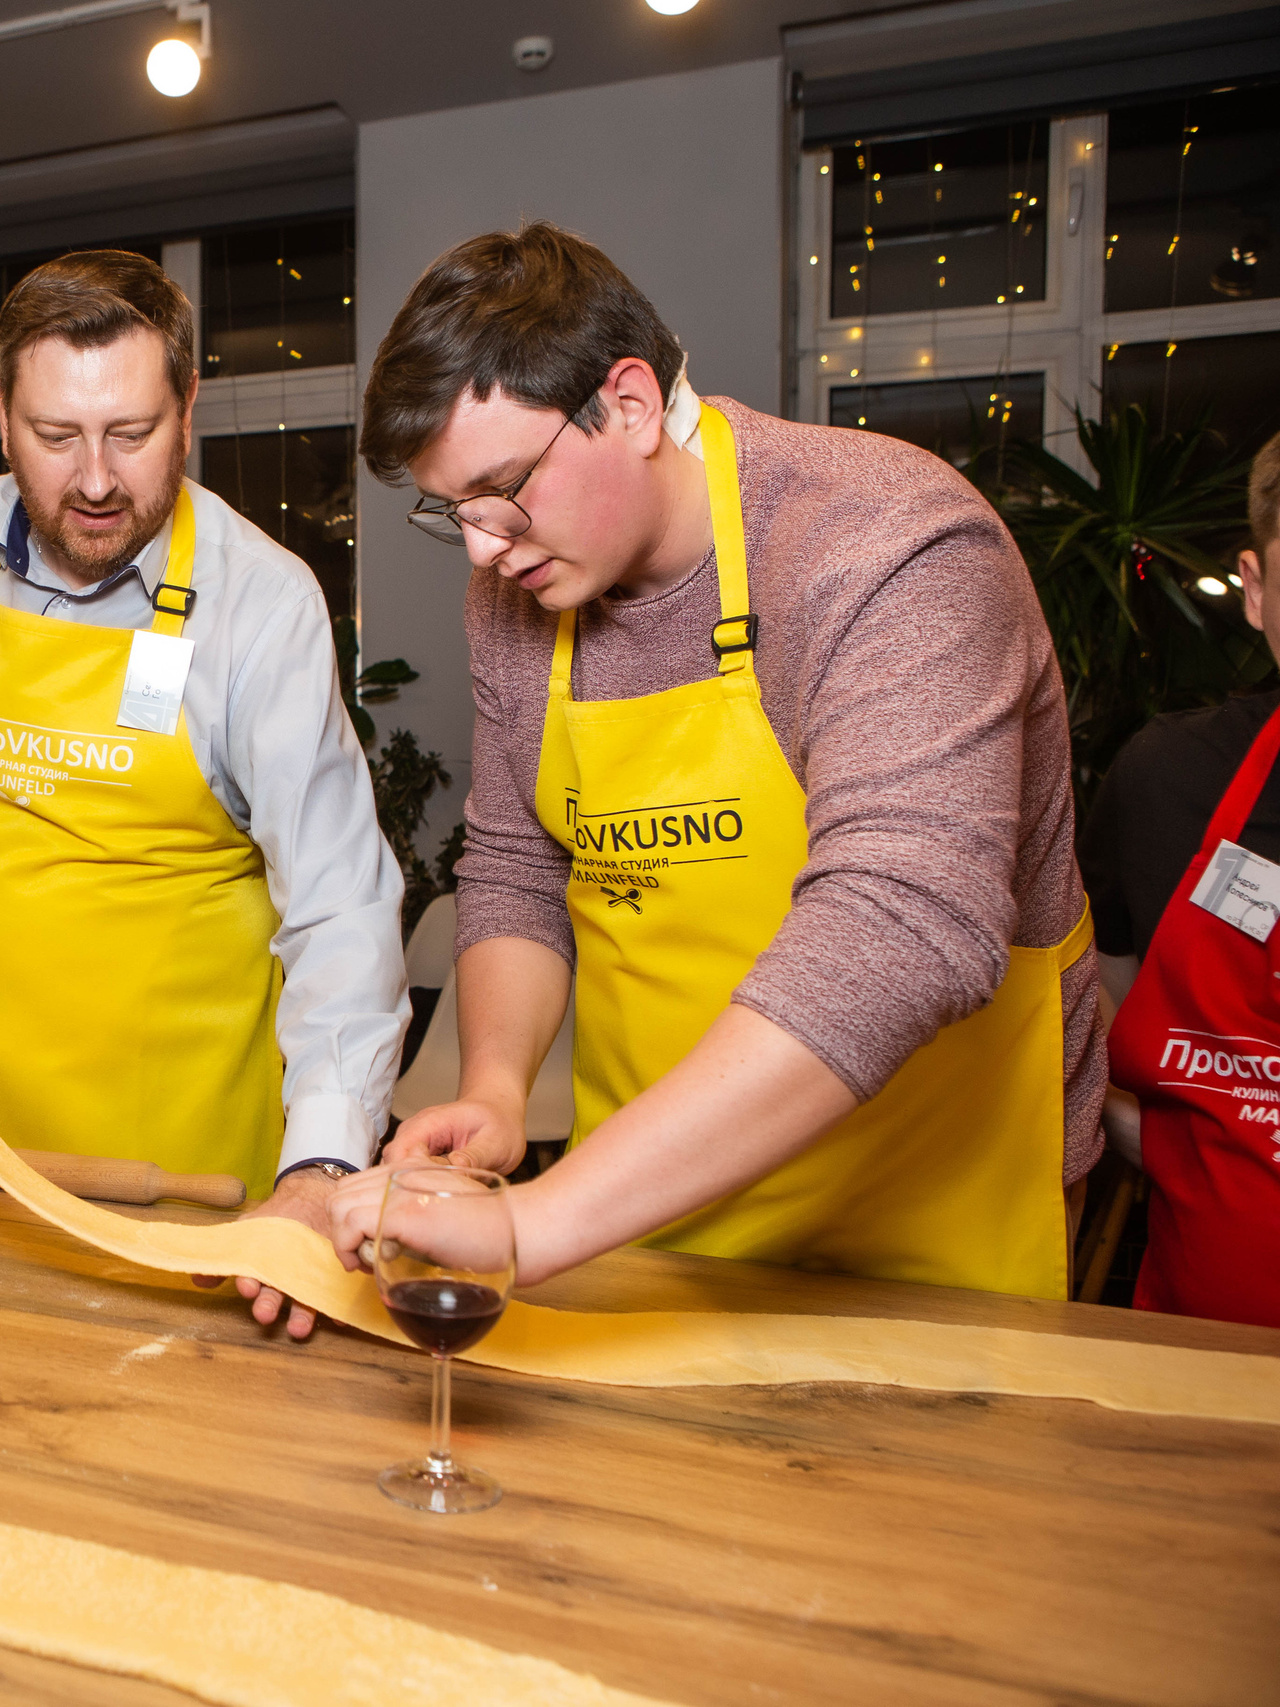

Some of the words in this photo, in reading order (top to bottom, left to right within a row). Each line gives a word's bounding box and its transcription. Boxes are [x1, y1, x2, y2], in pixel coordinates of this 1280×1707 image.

[28, 765, 69, 781] СТУДИЯ
[620, 857, 669, 872] СТУДИЯ
[572, 866, 659, 889] MAUNFELD
[1232, 872, 1261, 892] Андрей
